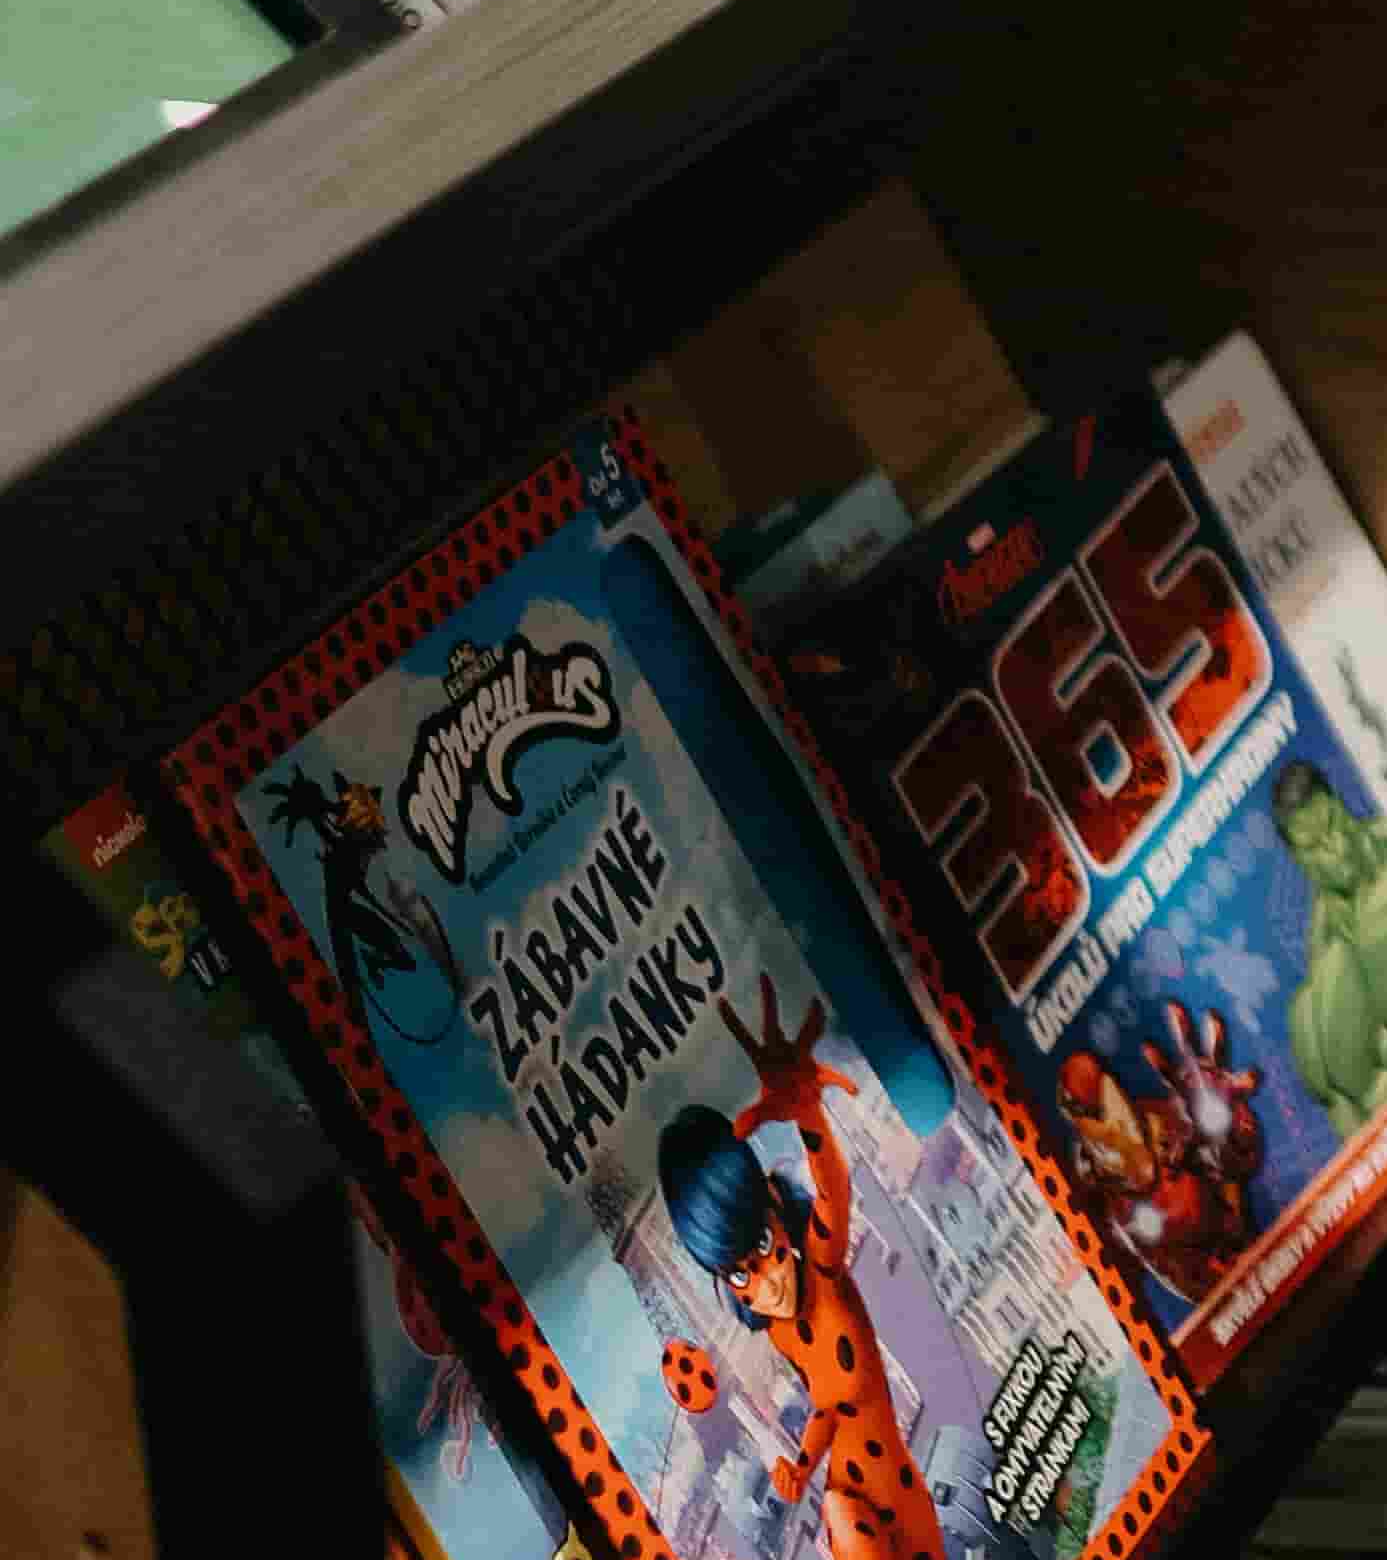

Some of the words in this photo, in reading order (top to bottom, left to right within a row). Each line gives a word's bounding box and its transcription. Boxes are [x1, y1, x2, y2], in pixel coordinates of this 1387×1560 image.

[890, 460, 1272, 1005] 365
[472, 790, 665, 1083] ZÁBAVNÉ
[526, 905, 724, 1185] HÁDANKY
[985, 1419, 1006, 1448] S
